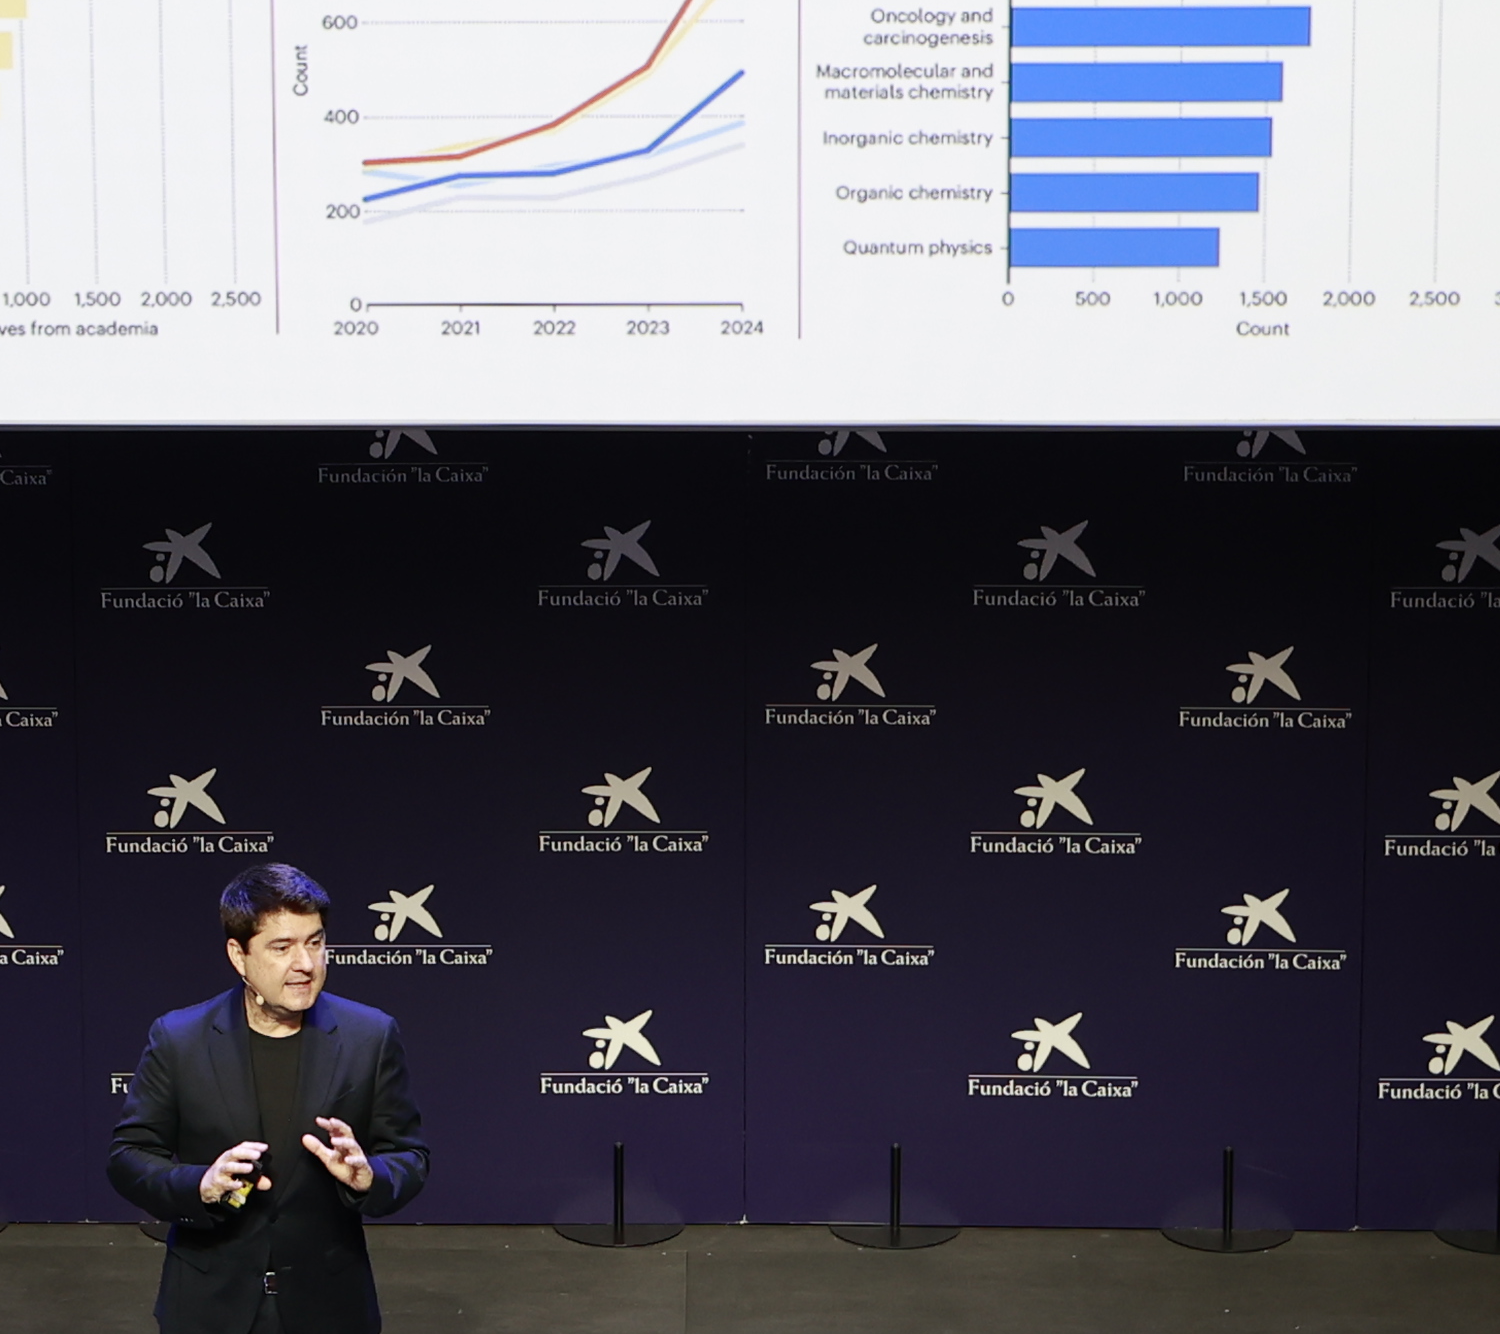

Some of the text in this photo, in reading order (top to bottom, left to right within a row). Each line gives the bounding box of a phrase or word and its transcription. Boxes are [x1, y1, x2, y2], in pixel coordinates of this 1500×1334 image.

[293, 45, 308, 96] Count
[30, 320, 71, 338] from
[75, 319, 159, 338] academia
[333, 319, 380, 337] 2020
[441, 319, 480, 337] 2021
[533, 319, 576, 337] 2022
[626, 318, 670, 337] 2023
[720, 319, 764, 336] 2024
[1235, 320, 1290, 338] Count
[320, 709, 410, 726] Fundación
[970, 835, 1055, 854] Fundació
[540, 1076, 623, 1094] Fundació
[1378, 1081, 1463, 1100] Fundació
